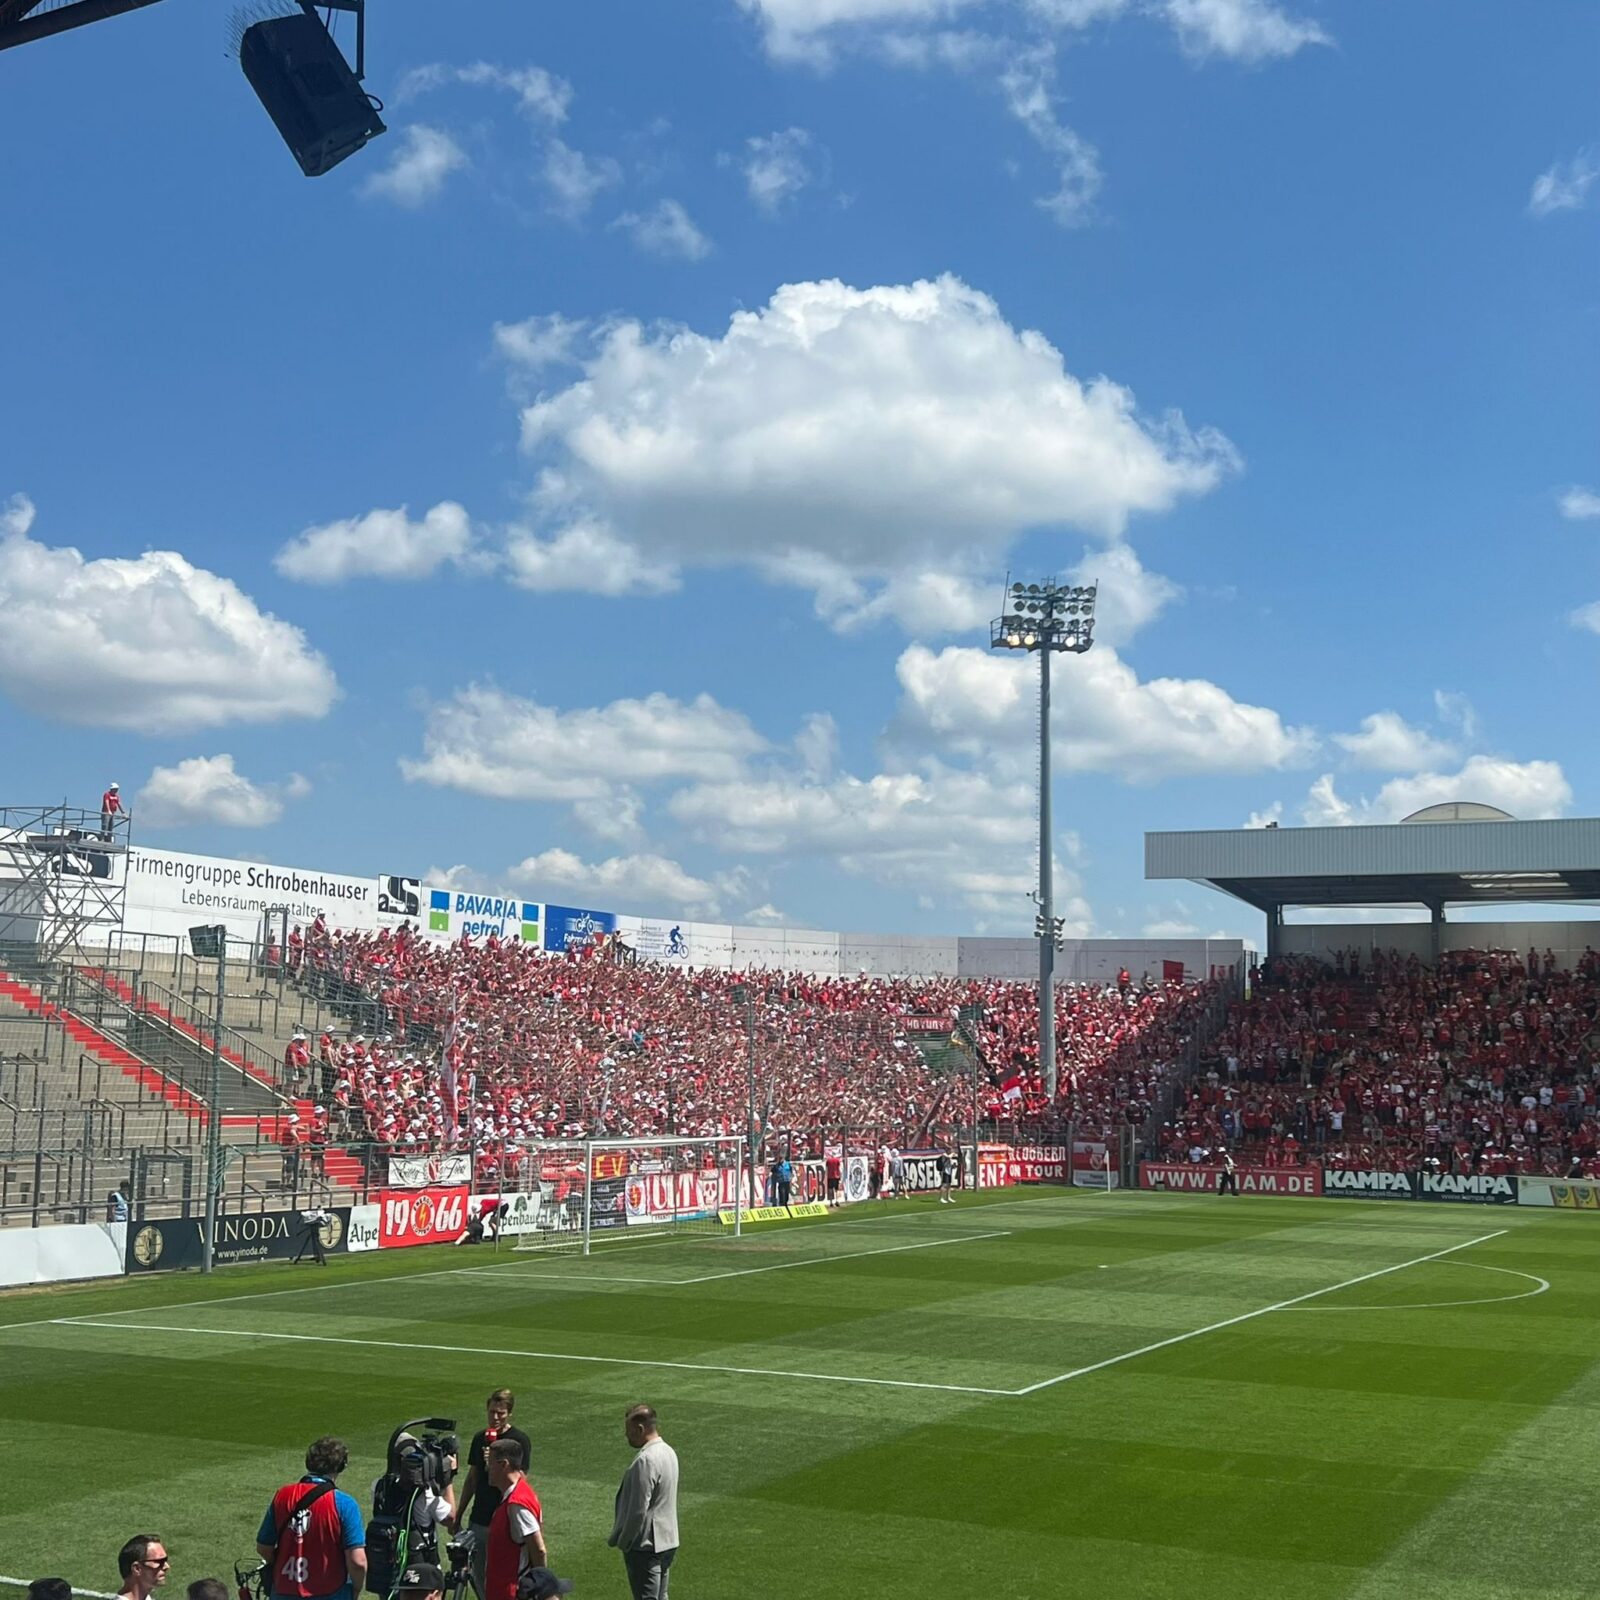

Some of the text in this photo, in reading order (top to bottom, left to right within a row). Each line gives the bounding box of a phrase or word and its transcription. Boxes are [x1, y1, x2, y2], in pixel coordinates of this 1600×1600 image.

[126, 851, 369, 901] Firmengruppe Schrobenhauser
[182, 889, 266, 913] Lebensräume
[455, 894, 517, 919] BAVARIA
[462, 919, 504, 938] petrol
[1025, 1164, 1063, 1178] TOUR
[1325, 1170, 1411, 1191] KAMPA
[1423, 1174, 1513, 1195] KAMPA
[349, 1223, 378, 1247] Alpe
[217, 1245, 268, 1262] www.vinoda.de
[282, 1555, 309, 1583] 48
